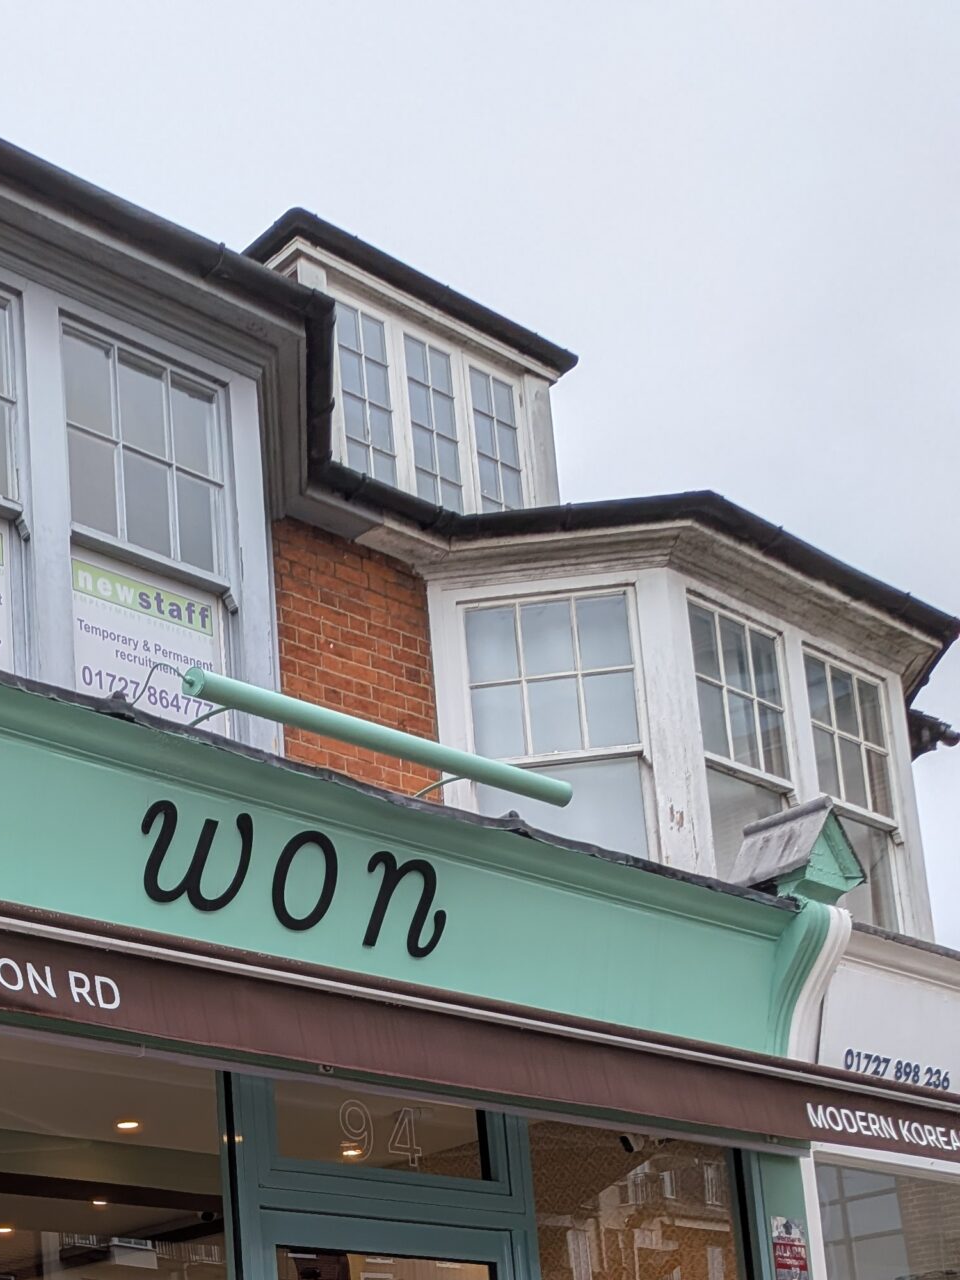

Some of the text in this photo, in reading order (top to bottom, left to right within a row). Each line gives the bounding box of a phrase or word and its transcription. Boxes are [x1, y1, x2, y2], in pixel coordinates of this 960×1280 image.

[78, 569, 209, 629] newstaff
[77, 618, 213, 672] Temporary & Permanent
[115, 648, 181, 677] recruitment
[82, 666, 213, 722] 01727 864777
[142, 800, 446, 958] won
[68, 970, 121, 1010] RD
[844, 1049, 950, 1090] 01727 898 236
[340, 1099, 422, 1166] 94
[806, 1103, 960, 1151] MODERN KOREA
